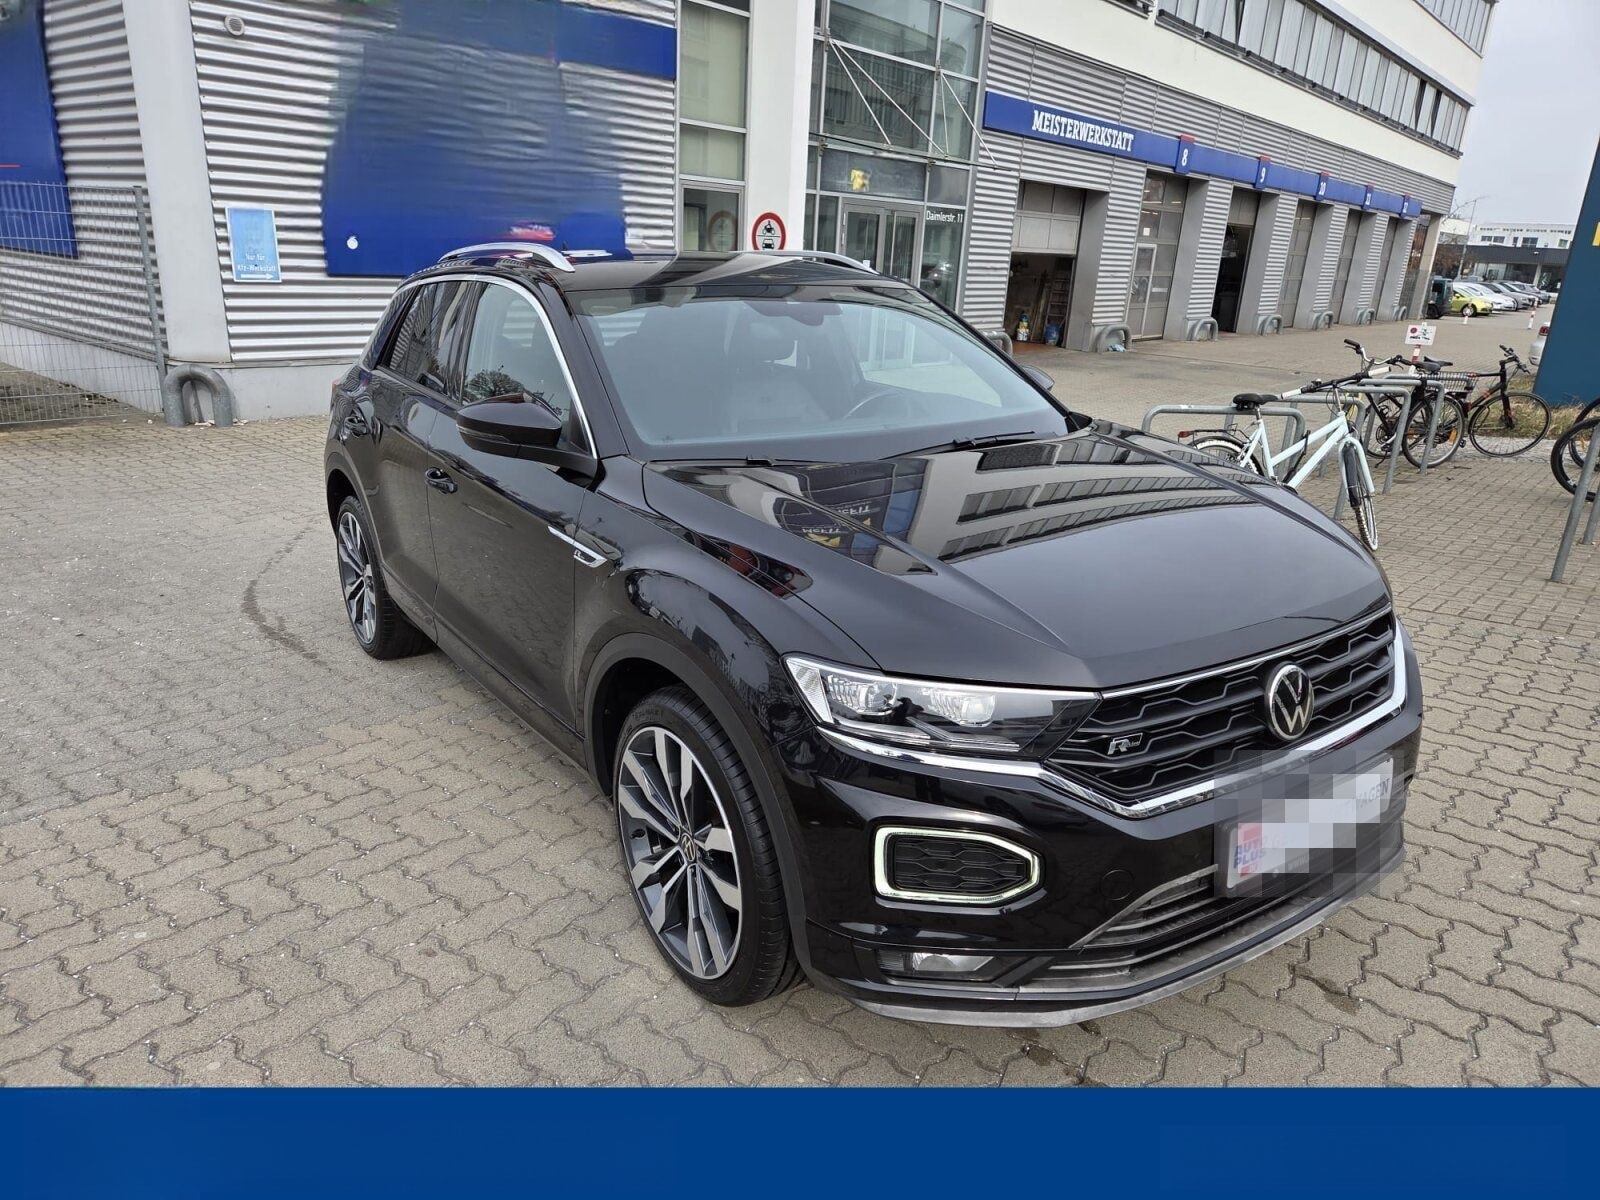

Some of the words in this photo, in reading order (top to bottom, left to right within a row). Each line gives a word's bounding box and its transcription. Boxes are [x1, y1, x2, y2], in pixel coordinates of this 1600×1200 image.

[1031, 109, 1134, 152] MEISTERWERKSTATT
[1181, 148, 1188, 167] 8
[1259, 167, 1266, 183] 9
[926, 210, 956, 223] Daimlerstr.
[957, 213, 963, 223] 11
[246, 253, 256, 261] Nur
